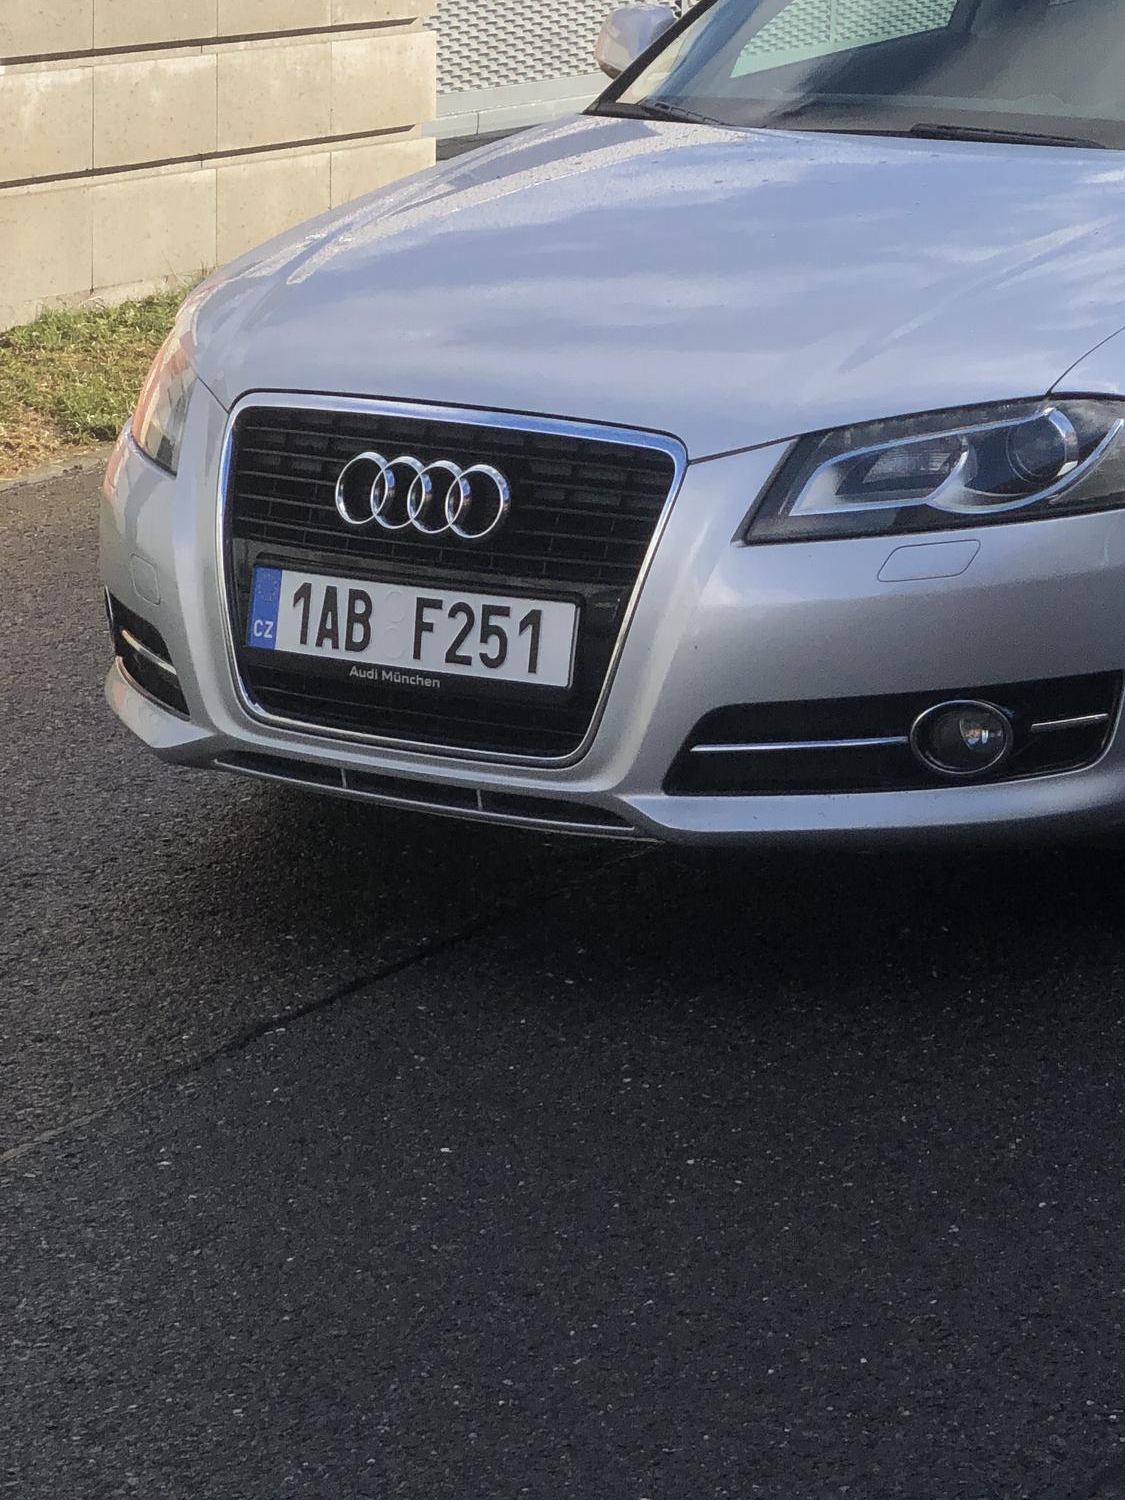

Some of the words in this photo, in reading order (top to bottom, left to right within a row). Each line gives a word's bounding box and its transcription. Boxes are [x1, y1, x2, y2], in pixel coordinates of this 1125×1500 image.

[253, 619, 274, 639] CZ
[293, 582, 373, 652] 1AB
[412, 596, 542, 673] F251
[349, 665, 378, 681] Audi
[381, 670, 441, 689] München
